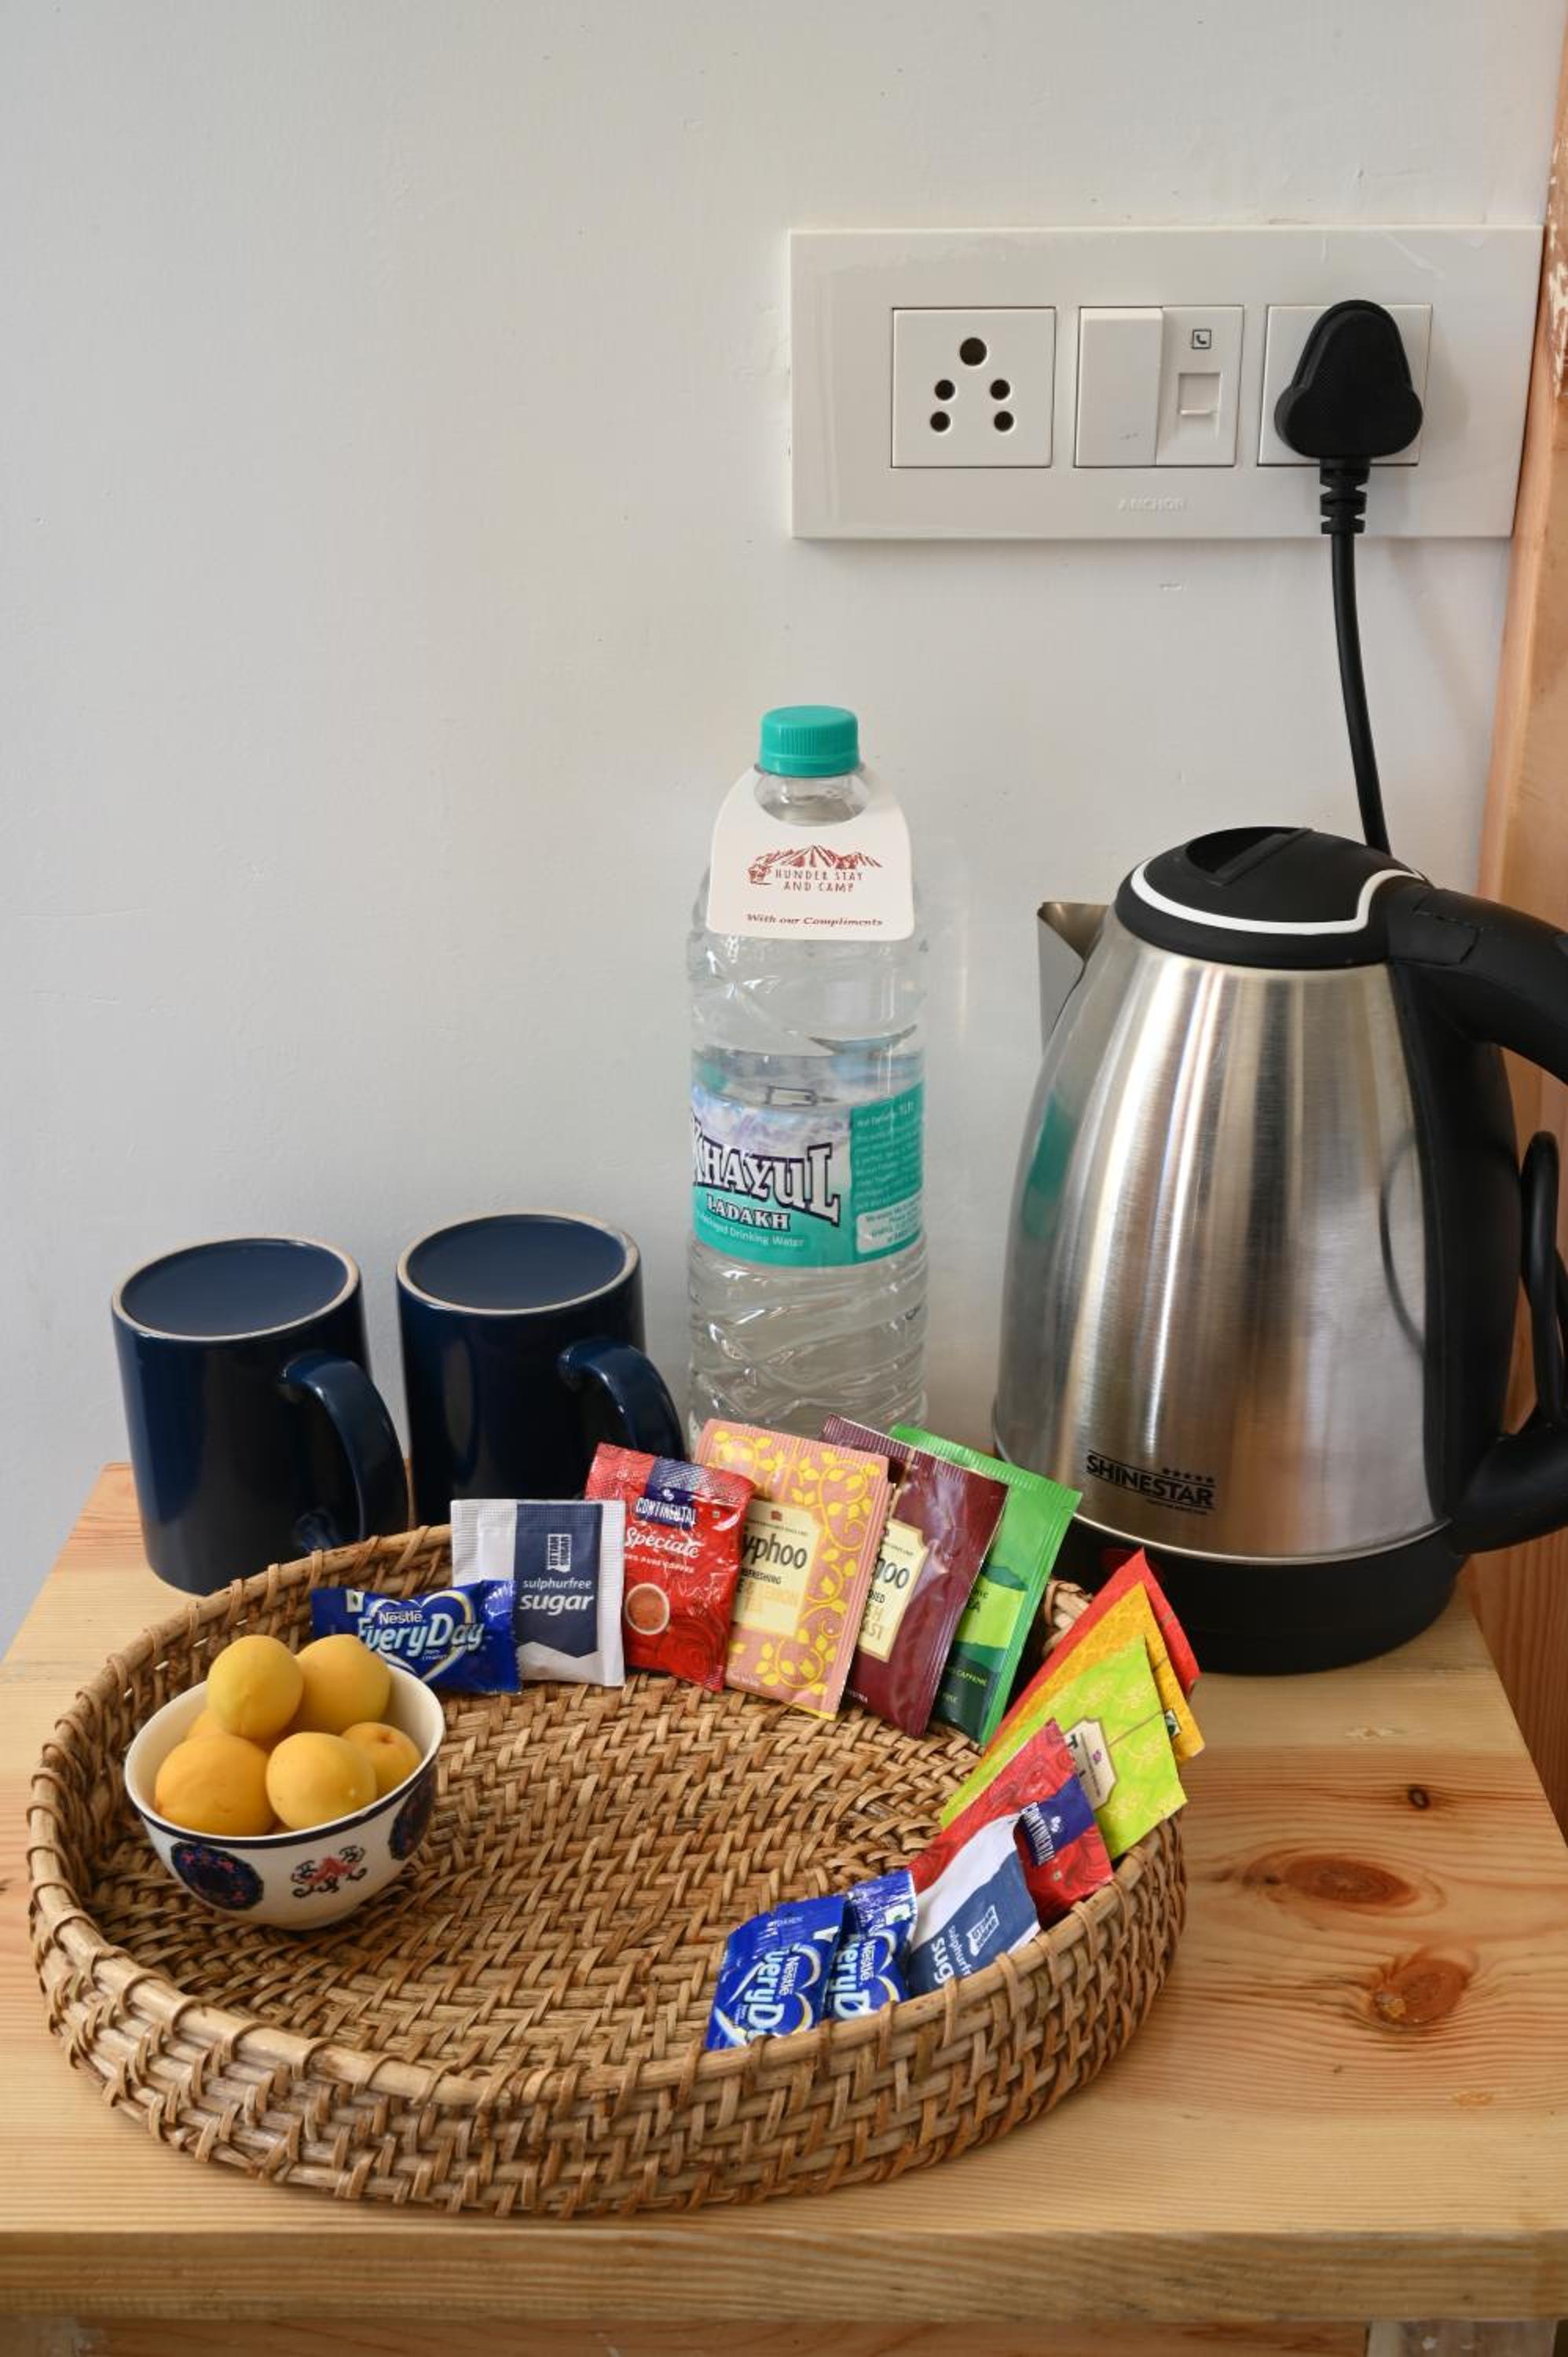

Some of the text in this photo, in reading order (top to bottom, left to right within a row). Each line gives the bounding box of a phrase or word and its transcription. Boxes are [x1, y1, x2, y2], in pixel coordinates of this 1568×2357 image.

[783, 882, 855, 893] AND CAMP
[835, 871, 863, 881] STAY
[746, 913, 777, 924] With
[803, 916, 883, 927] Compliments
[707, 1193, 791, 1232] LADAKH
[729, 1226, 770, 1245] Drinking
[771, 1234, 805, 1248] Water
[1086, 1453, 1215, 1507] SHINESTAR
[741, 1533, 808, 1569] yphoo
[523, 1577, 592, 1591] sulphurfree
[519, 1594, 595, 1616] sugar
[357, 1612, 485, 1658] EveryDay
[930, 1936, 954, 1985] sug
[743, 1948, 787, 2033] veryD
